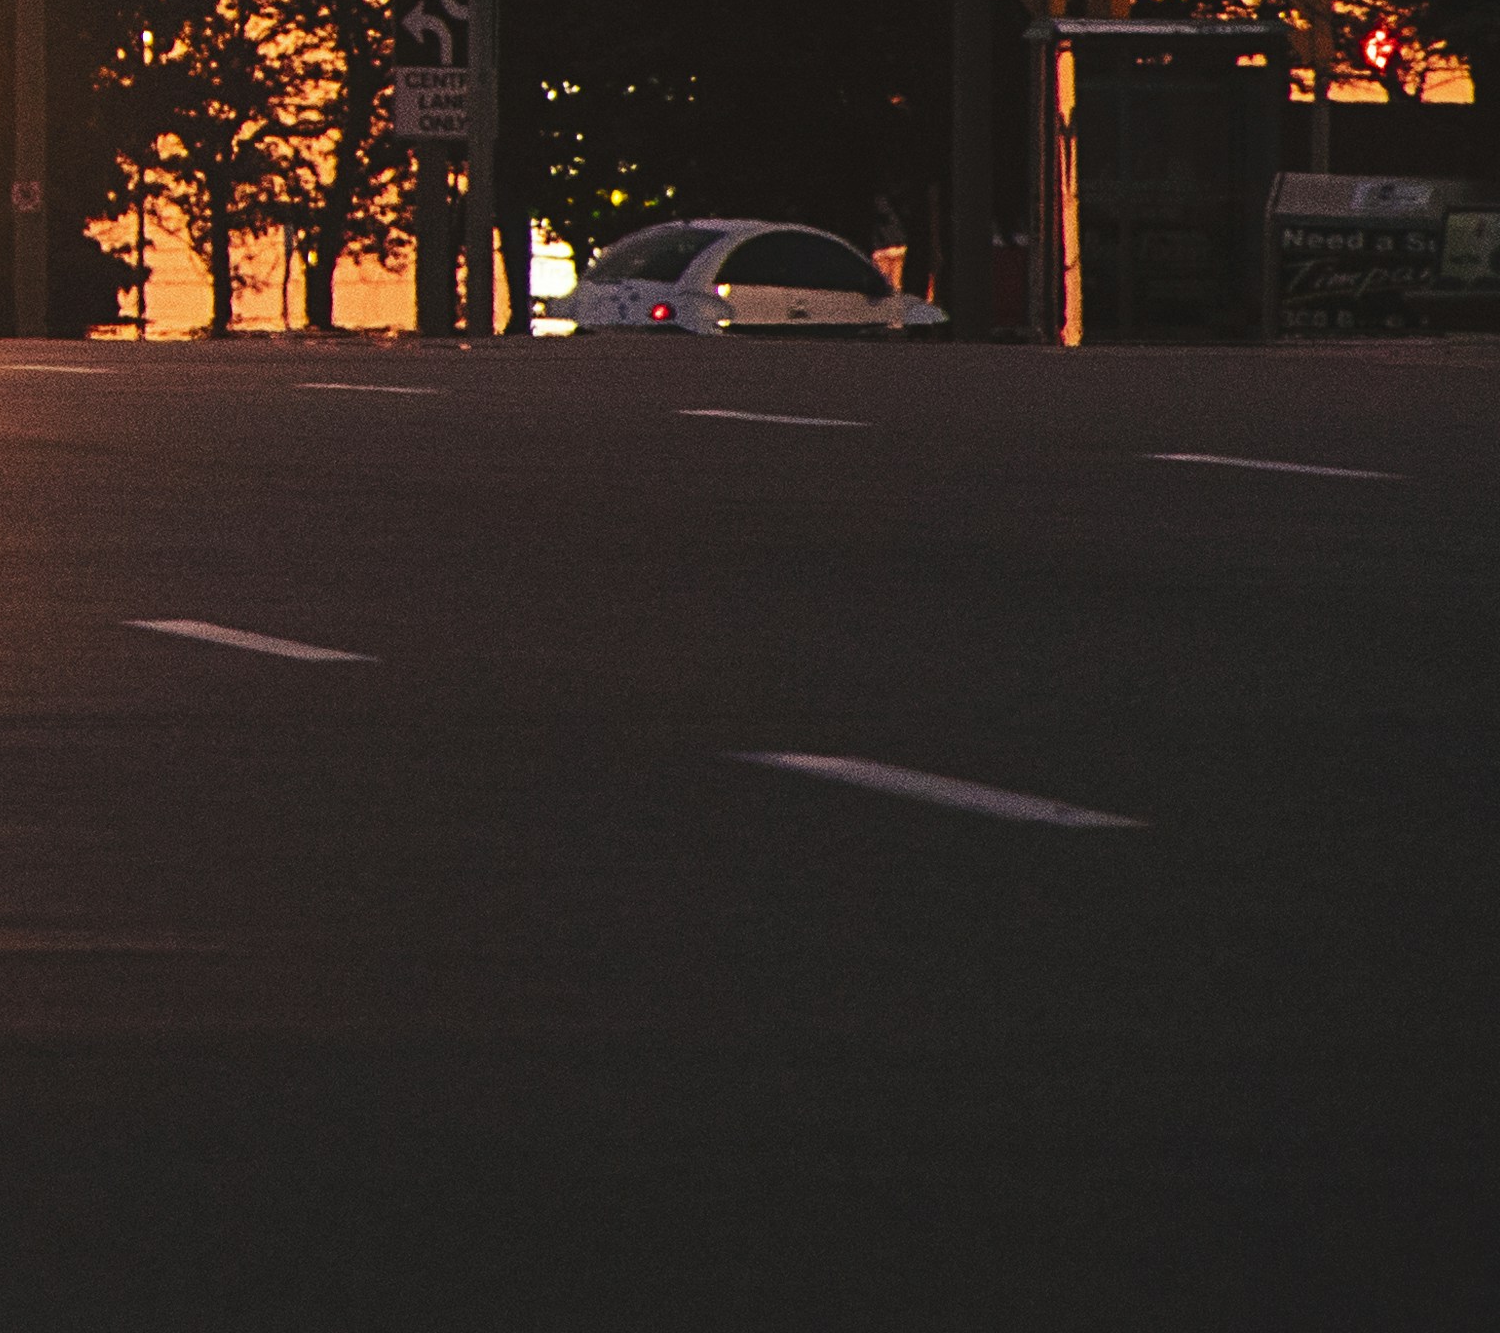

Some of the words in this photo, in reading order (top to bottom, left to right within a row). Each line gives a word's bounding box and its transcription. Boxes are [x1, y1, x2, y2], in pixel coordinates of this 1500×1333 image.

[419, 115, 473, 132] ONLY
[1282, 228, 1364, 251] Need
[1375, 234, 1395, 252] a
